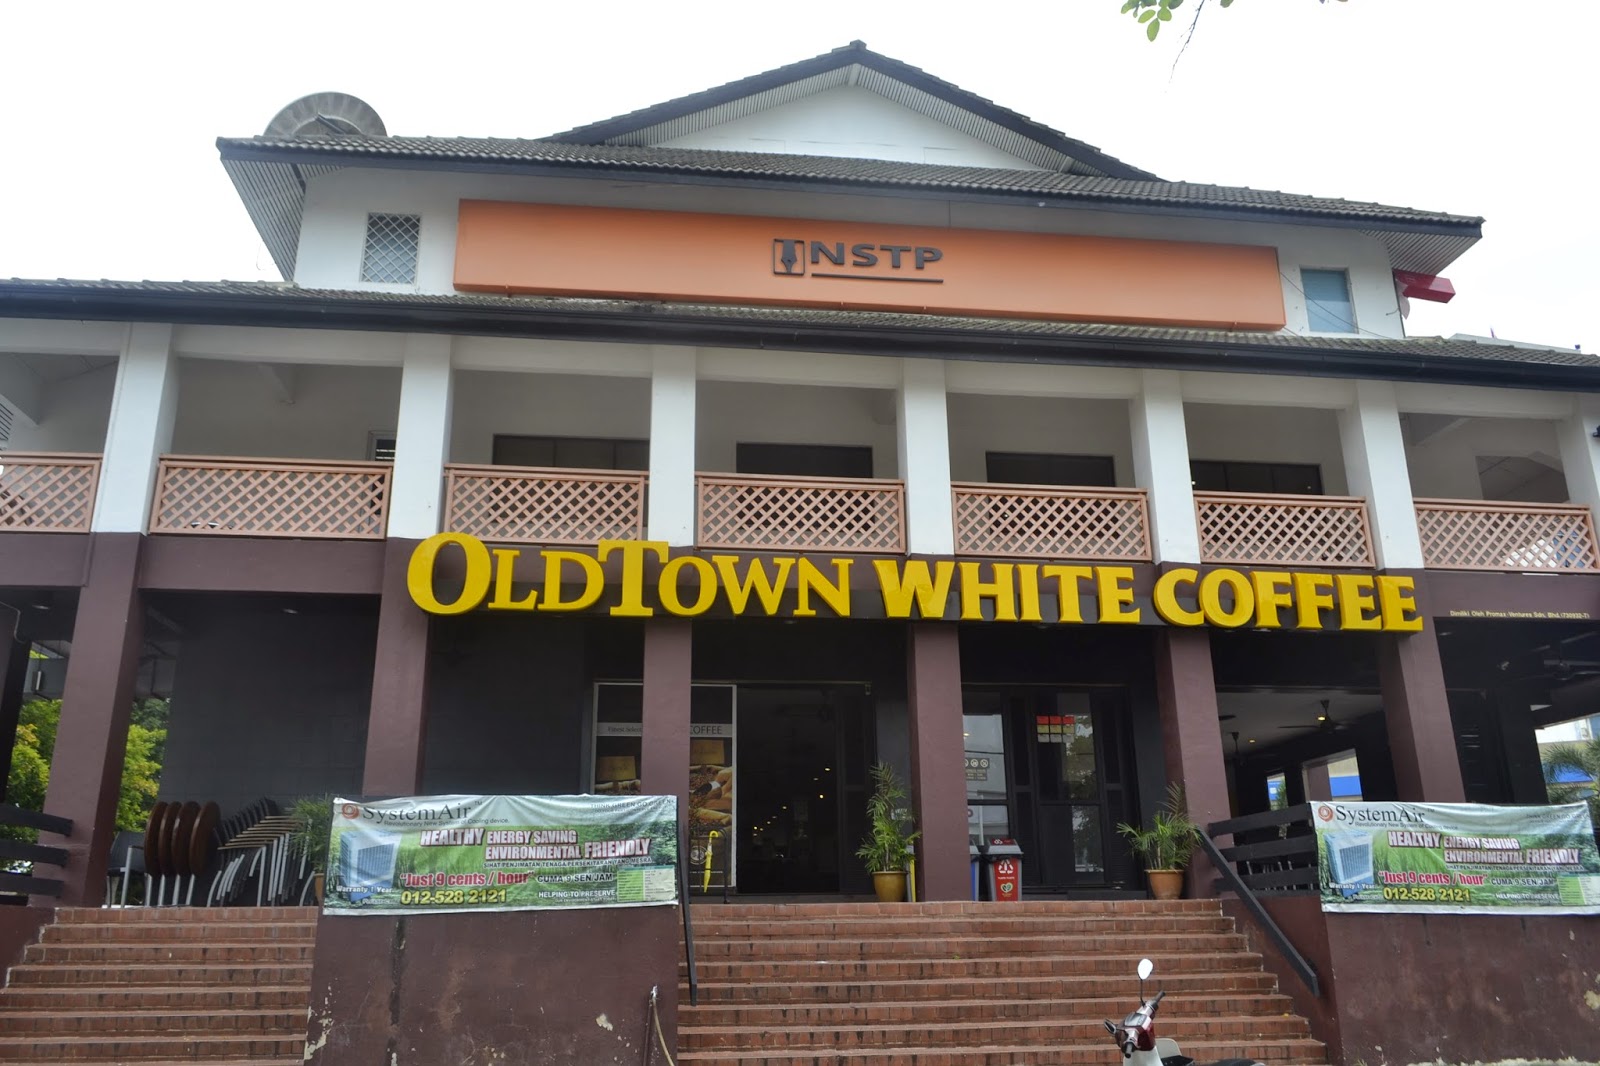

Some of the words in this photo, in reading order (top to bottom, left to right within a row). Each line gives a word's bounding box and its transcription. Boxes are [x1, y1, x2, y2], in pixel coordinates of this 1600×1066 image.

[811, 240, 943, 270] NSTP
[873, 559, 1141, 623] WHITE
[1154, 568, 1423, 632] COFFEE
[362, 802, 471, 824] SystemAir
[1336, 806, 1425, 825] SystemAir
[420, 829, 484, 846] HEALTHY
[486, 830, 532, 845] ENERGY
[533, 830, 578, 844] SAVING
[1388, 831, 1442, 848] HEALTHY
[1444, 836, 1482, 849] ENERGY
[1482, 838, 1520, 850] SAVING
[486, 846, 581, 860] ENVIRONMENTAL
[584, 838, 651, 859] FRIENDLY
[1444, 850, 1524, 863] ENVIRONMENTAL
[1526, 848, 1579, 864] FRIENDLY
[436, 873, 446, 886] 9
[448, 873, 485, 886] cents
[1408, 872, 1417, 883] 9
[1418, 872, 1450, 885] cents
[401, 890, 464, 905] 012-528
[468, 889, 507, 904] 2121
[1384, 887, 1435, 900] 012-528
[1440, 888, 1470, 901] 2121
